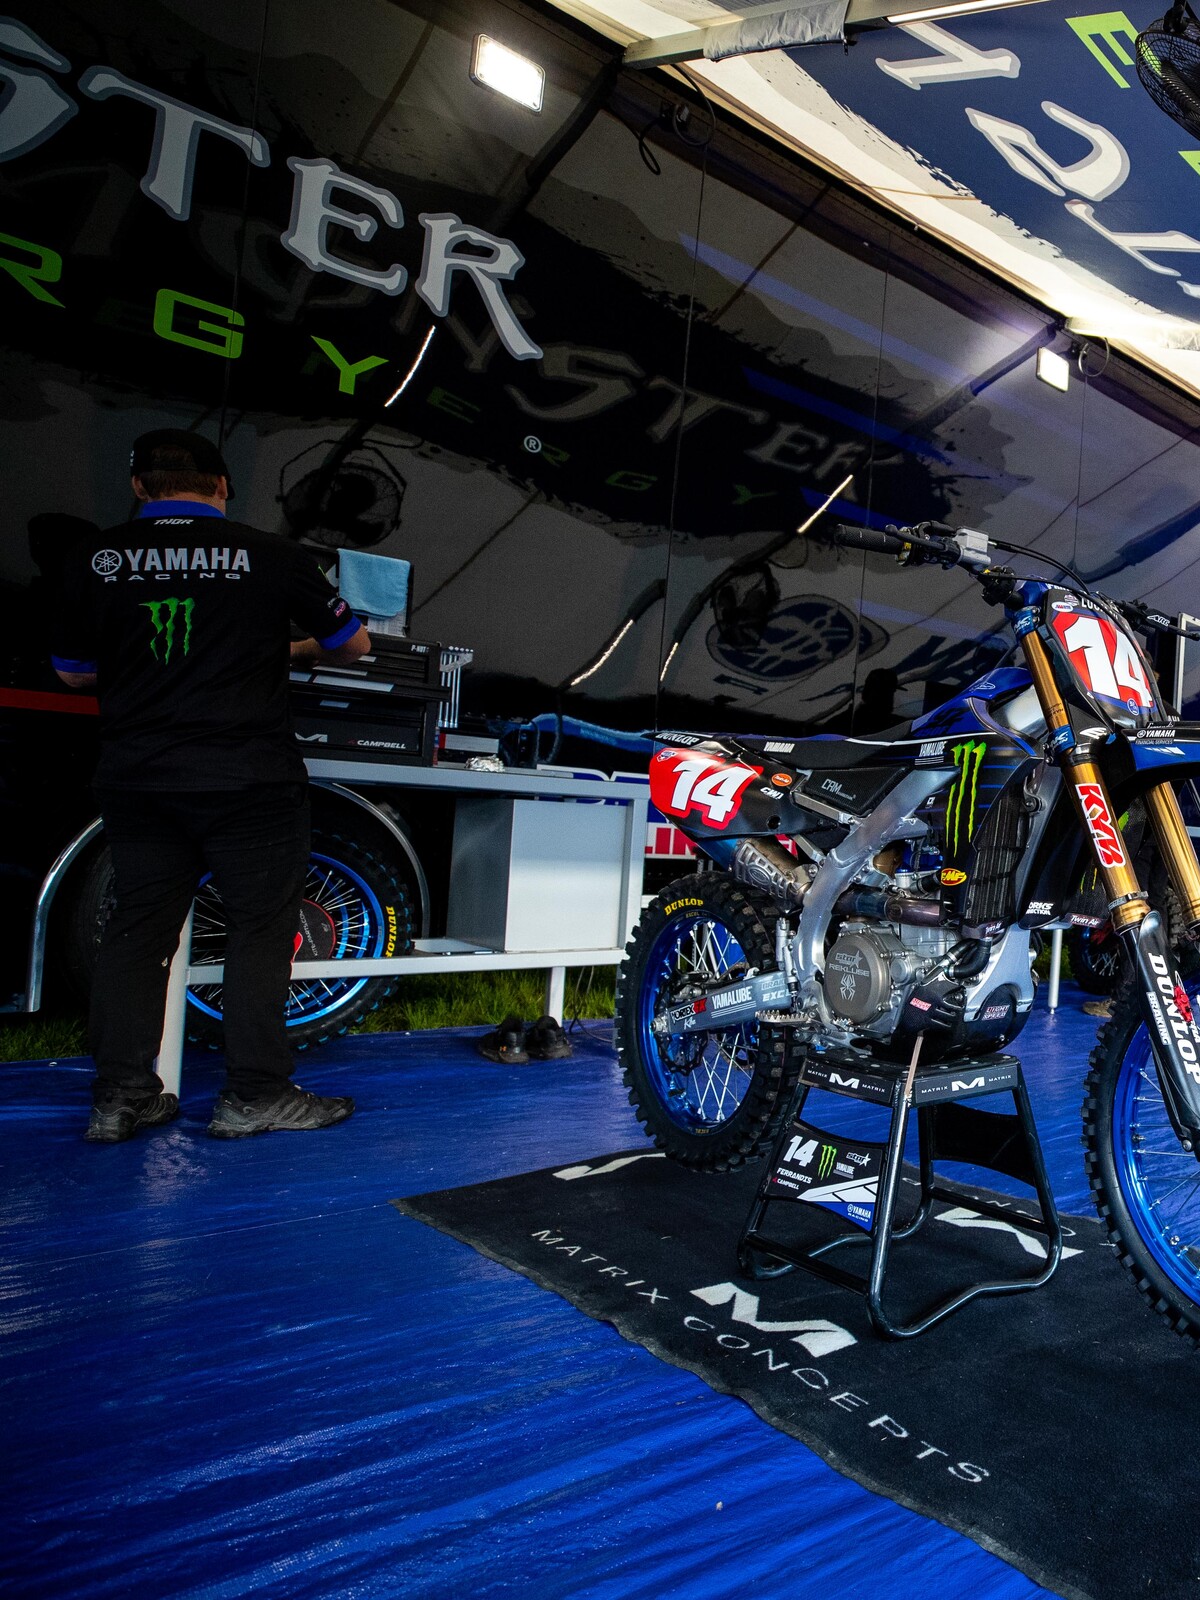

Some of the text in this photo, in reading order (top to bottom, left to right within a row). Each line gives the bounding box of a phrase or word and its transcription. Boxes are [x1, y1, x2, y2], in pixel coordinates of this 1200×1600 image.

[153, 518, 195, 526] THOR
[124, 547, 251, 572] YAMAHA
[104, 572, 241, 583] RACING
[1063, 616, 1153, 708] 14
[1145, 730, 1176, 738] YAMAHA
[357, 739, 407, 750] CAMPBELL
[671, 758, 757, 823] 14
[1075, 783, 1127, 869] KYB
[663, 898, 704, 916] DUNLOP
[829, 963, 870, 977] REKLUSE
[712, 985, 753, 1010] YAMALUBE
[862, 1083, 886, 1093] MATRIX
[921, 1085, 948, 1094] MATRIX
[988, 1074, 1012, 1082] MATRIX
[783, 1134, 819, 1168] 14
[776, 1167, 813, 1185] FERRANDIS
[852, 1205, 872, 1219] YAMAHA
[532, 1228, 670, 1305] MATRIX
[682, 1314, 991, 1484] CONCEPTS
